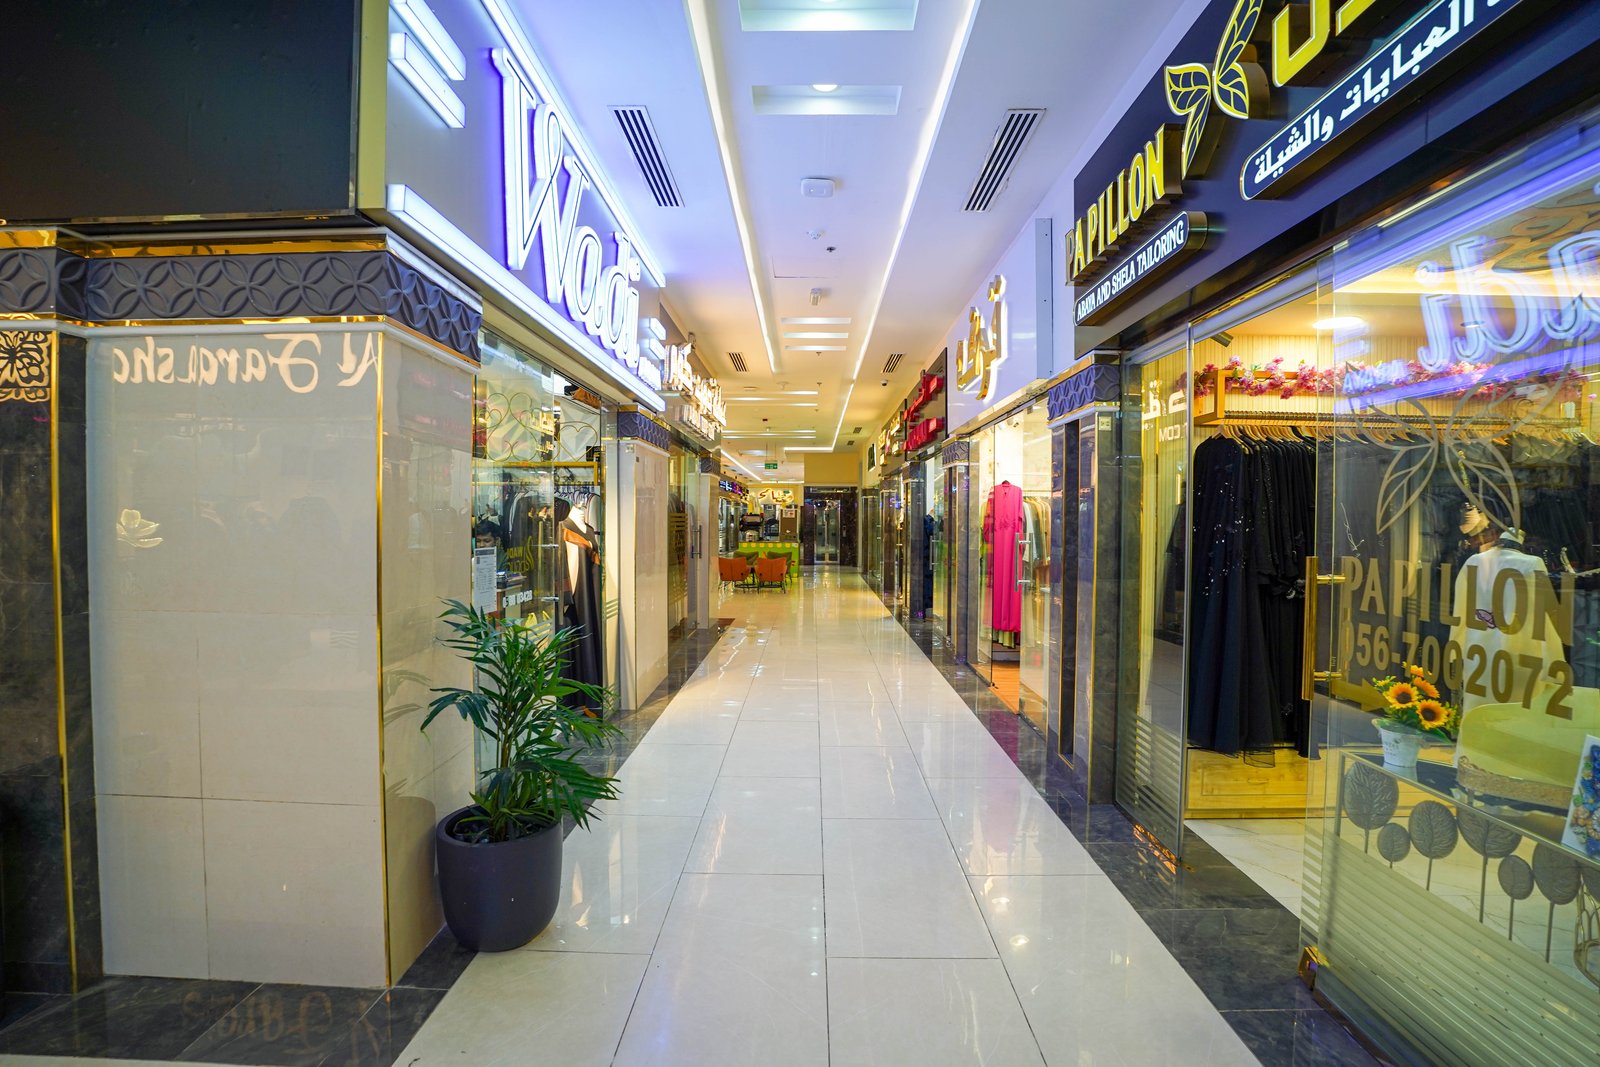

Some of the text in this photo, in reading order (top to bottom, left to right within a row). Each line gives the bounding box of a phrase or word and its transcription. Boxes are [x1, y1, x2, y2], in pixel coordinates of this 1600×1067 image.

[1254, 109, 1334, 184] والشيلة
[491, 47, 640, 368] Wadi
[1065, 123, 1166, 286] PAPILLON
[1077, 219, 1185, 321] ABAYA AND SHELA TAILORING
[1340, 555, 1576, 647] PAPILLON
